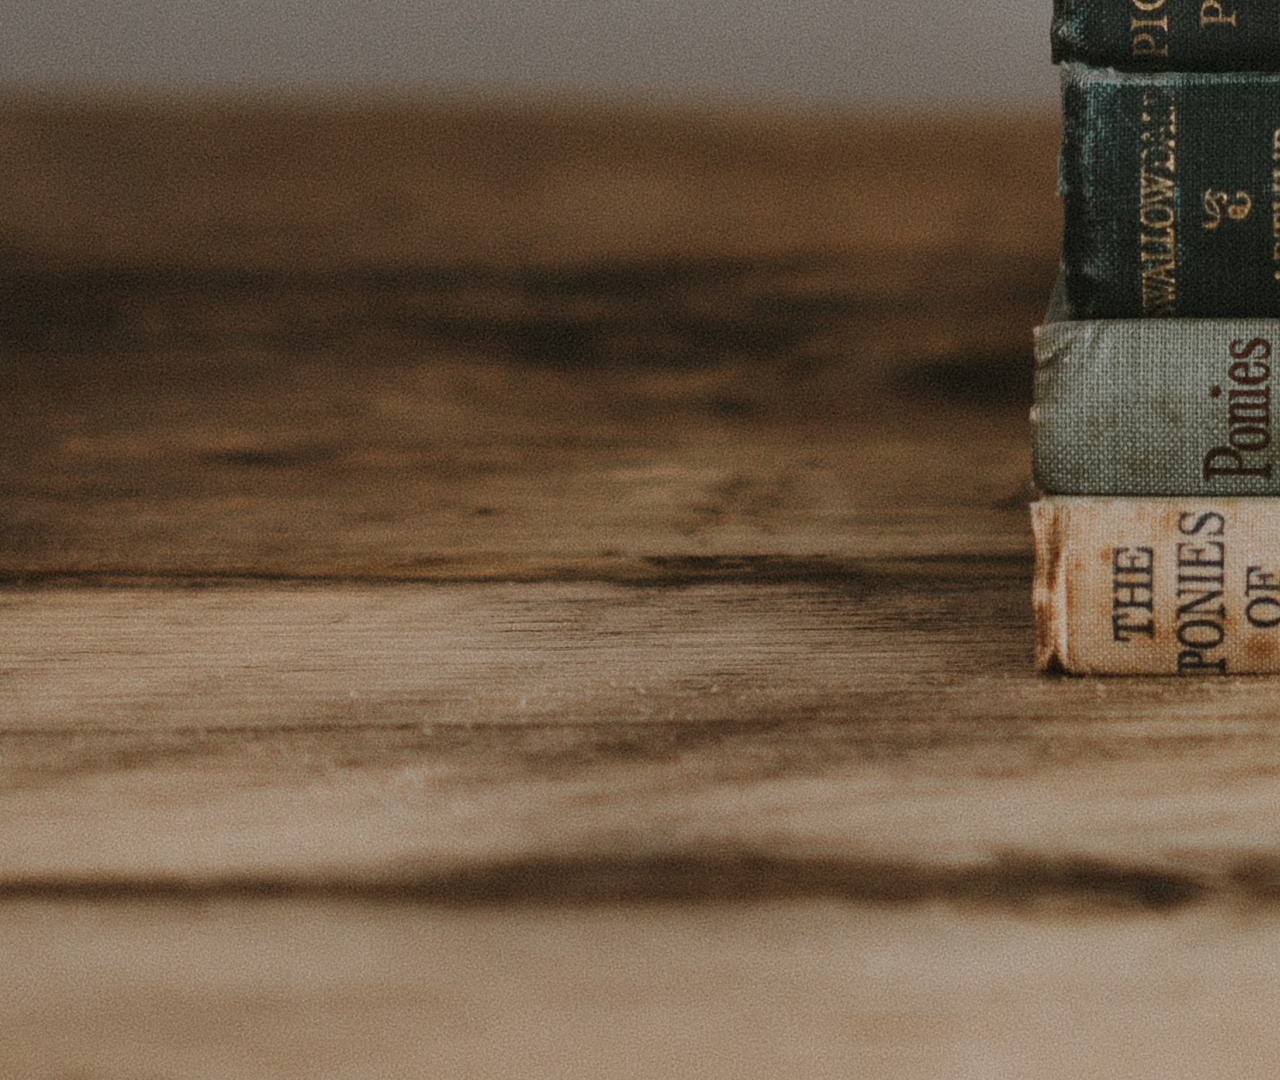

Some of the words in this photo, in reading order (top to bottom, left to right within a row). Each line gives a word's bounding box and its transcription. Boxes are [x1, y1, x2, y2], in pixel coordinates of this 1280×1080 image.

[1203, 337, 1271, 481] Ponies
[1112, 547, 1153, 642] THE
[1175, 511, 1226, 673] PONIES
